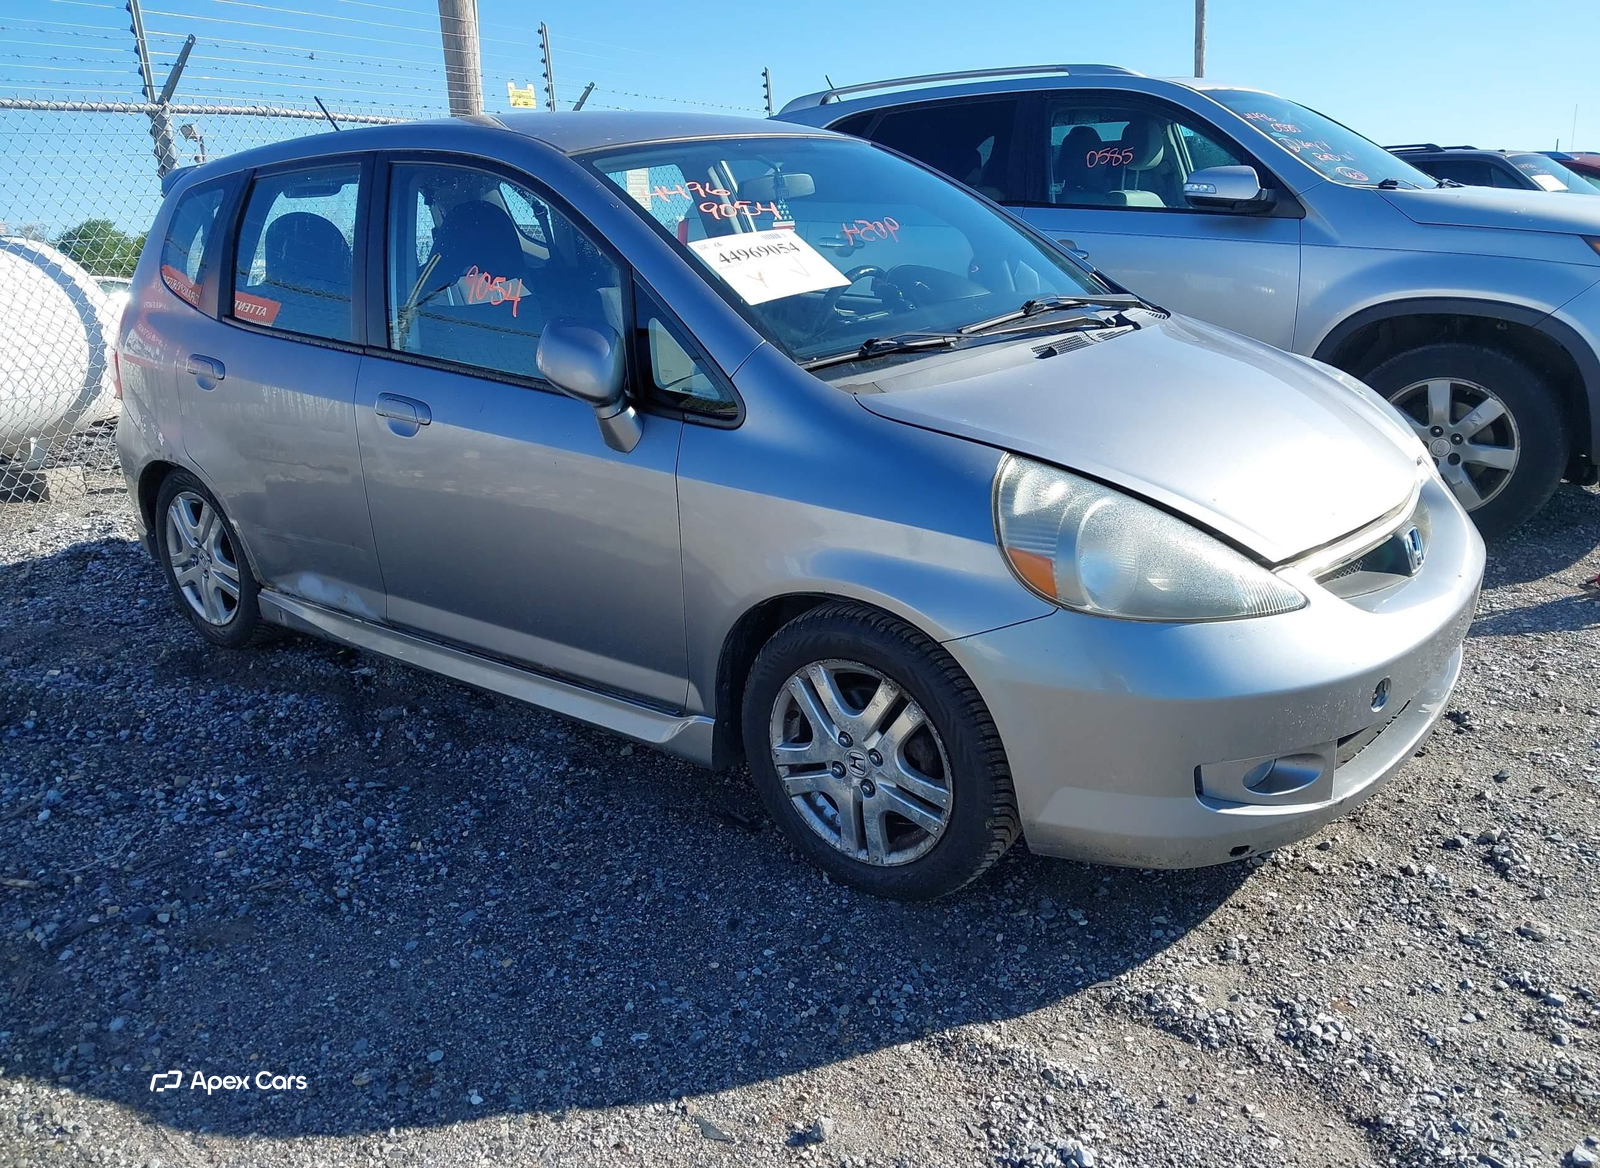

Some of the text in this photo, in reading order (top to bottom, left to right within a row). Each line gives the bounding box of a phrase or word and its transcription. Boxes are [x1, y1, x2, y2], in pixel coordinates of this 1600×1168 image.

[1086, 146, 1135, 168] 0585
[640, 181, 731, 204] 4496
[699, 200, 783, 220] 9054
[719, 242, 801, 264] 44969054
[466, 265, 522, 318] 9054
